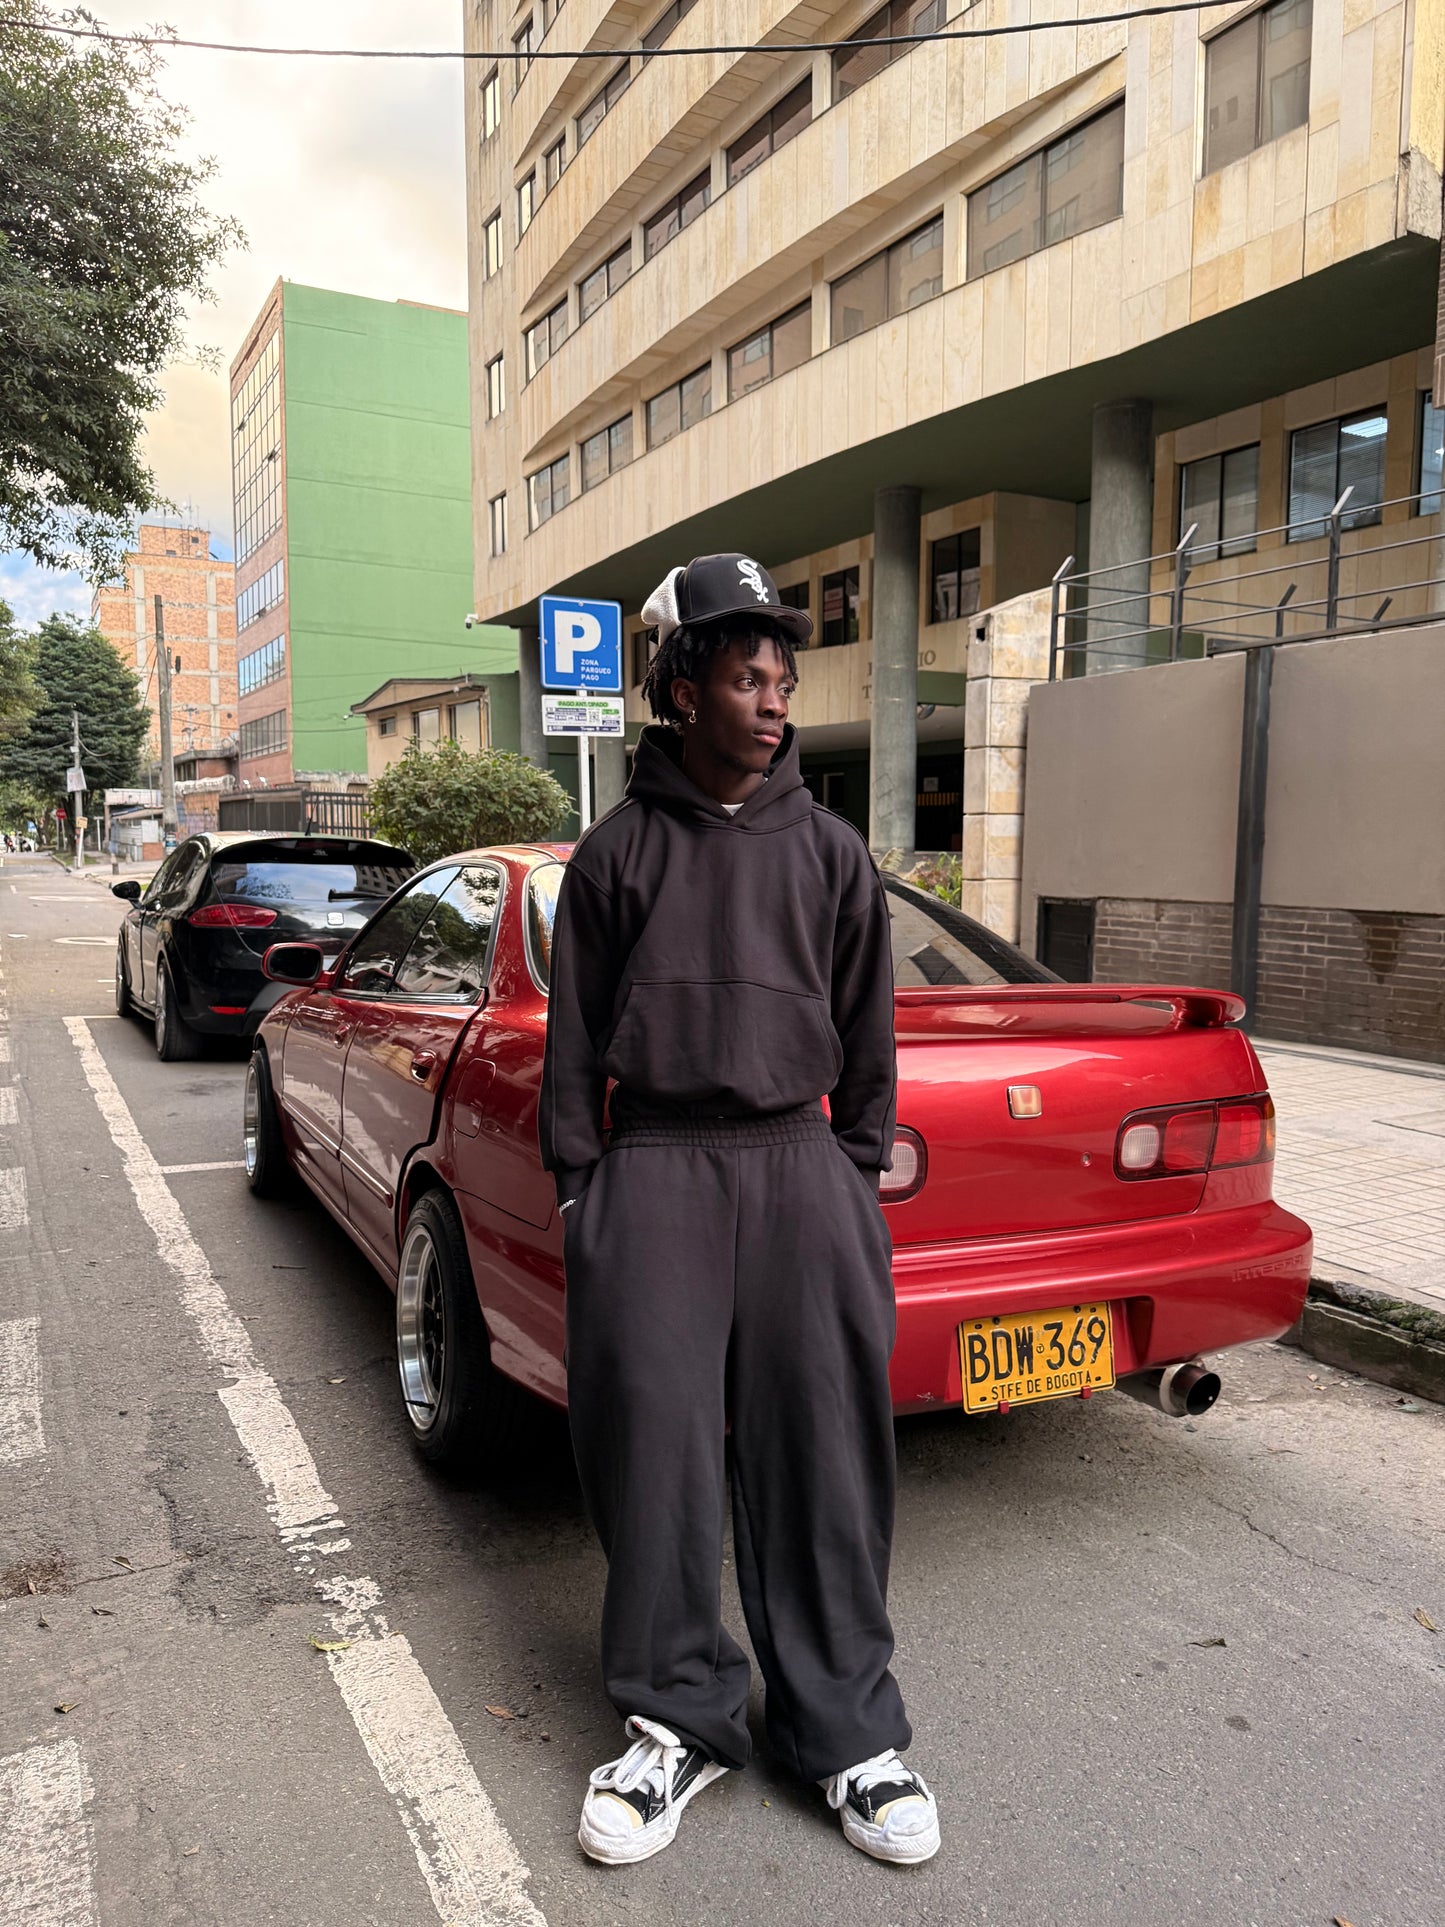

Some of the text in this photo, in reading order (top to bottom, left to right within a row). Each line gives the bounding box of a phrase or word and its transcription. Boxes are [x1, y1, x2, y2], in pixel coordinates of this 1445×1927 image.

[737, 559, 769, 603] Sox
[554, 610, 601, 673] P
[967, 1316, 1106, 1384] BDW 369
[992, 1370, 1091, 1400] STFE DE BOGOTA
